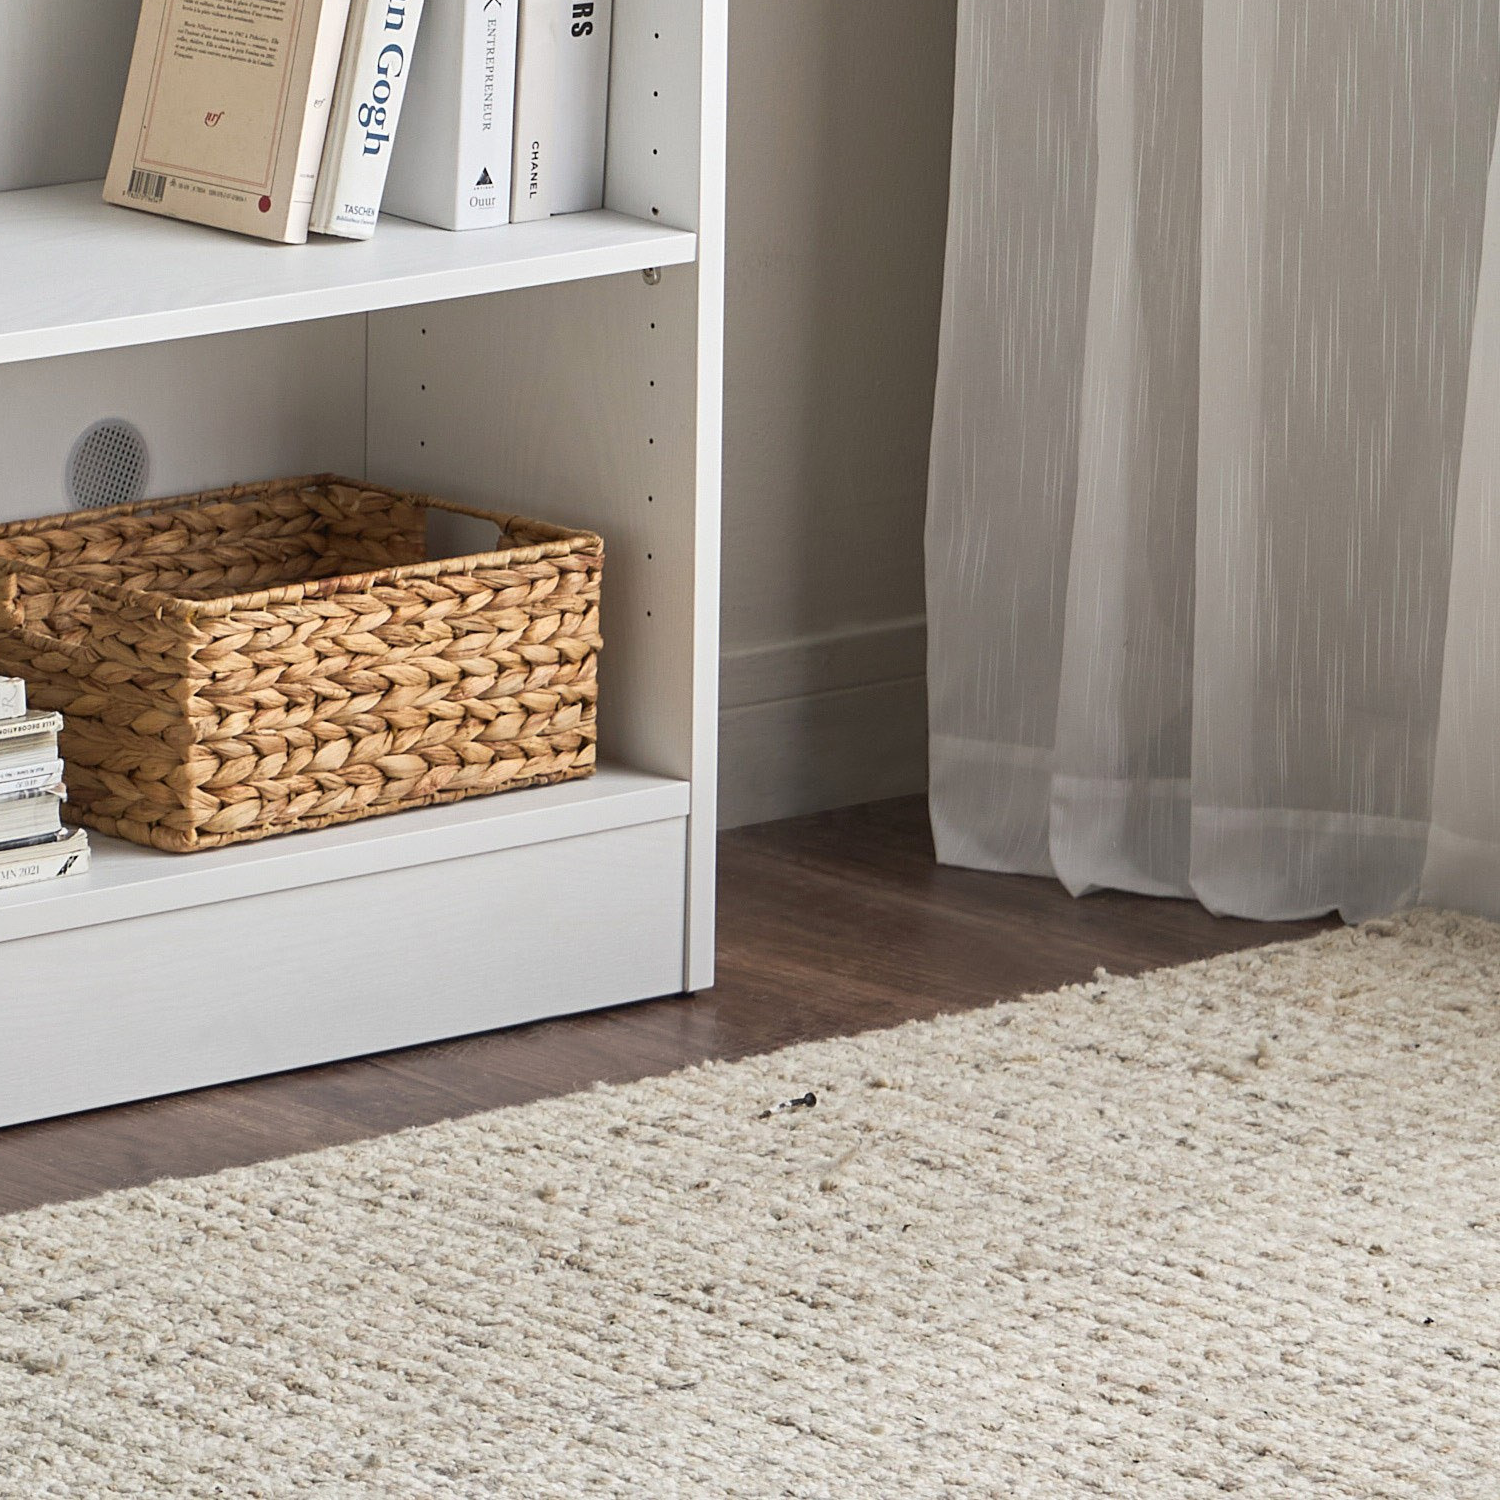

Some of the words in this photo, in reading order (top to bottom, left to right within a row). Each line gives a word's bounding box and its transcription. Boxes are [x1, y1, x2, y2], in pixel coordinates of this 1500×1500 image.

[482, 18, 496, 131] ENTREPRENEUR
[358, 43, 404, 156] Gogh
[529, 141, 539, 199] CHANEL
[344, 204, 375, 217] TASCHEN
[469, 196, 496, 208] Ouur
[19, 865, 40, 878] 2021
